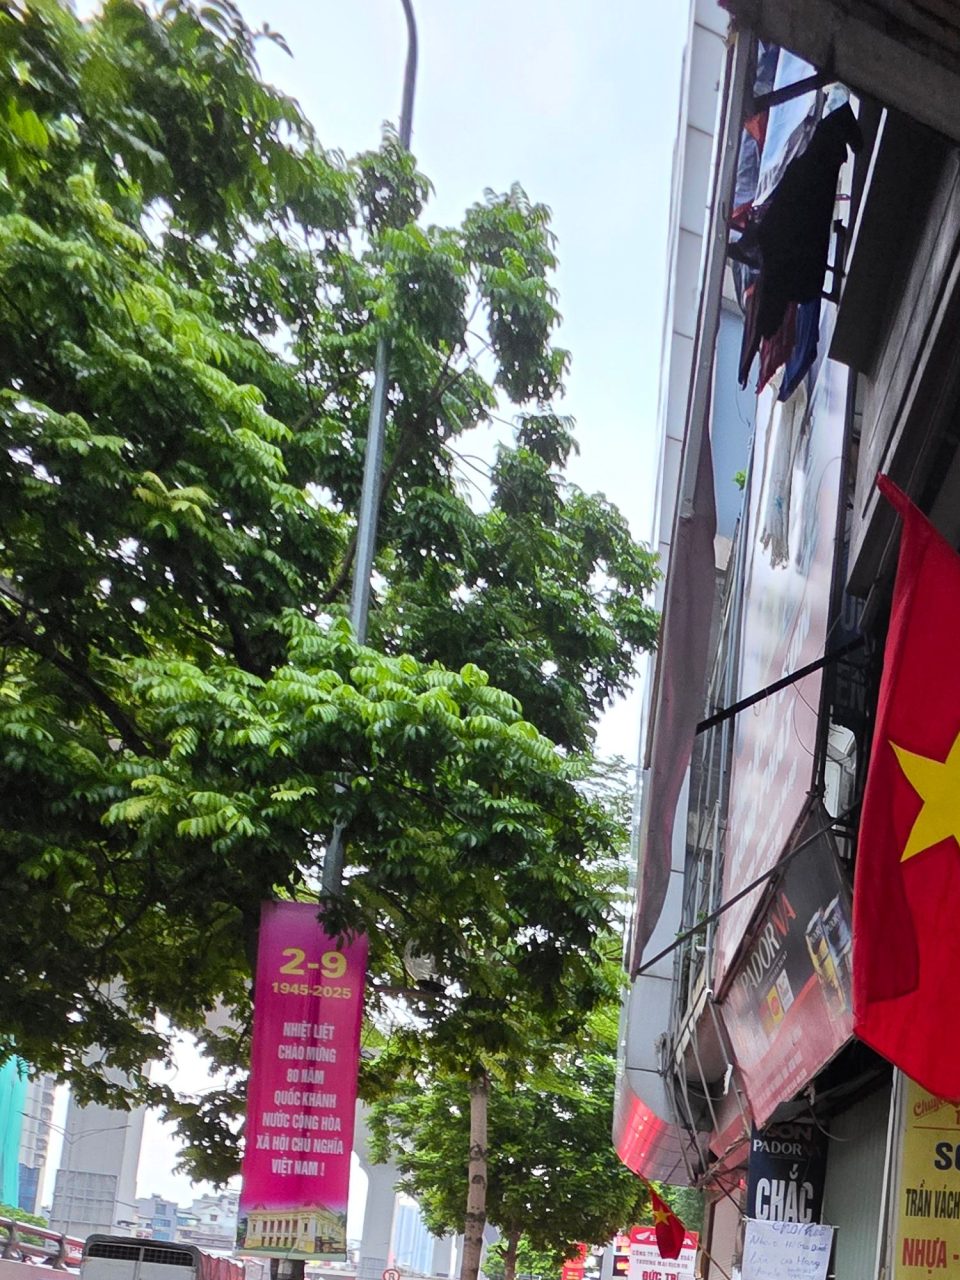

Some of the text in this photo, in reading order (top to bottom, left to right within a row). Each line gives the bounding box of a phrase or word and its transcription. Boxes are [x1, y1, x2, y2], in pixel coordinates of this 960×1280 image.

[280, 948, 347, 978] 2-9
[272, 982, 352, 999] 1945-2025
[283, 1021, 335, 1042] NHIỆT LIỆT
[278, 1043, 336, 1063] CHÀO MỪNG
[286, 1067, 325, 1084] 80 NĂM
[274, 1086, 336, 1108] QUỐC KHÁNH
[262, 1109, 341, 1132] NƯỚC CỘNG HÒA
[256, 1132, 344, 1154] XÃ HỘI CHỦ NGHĨA
[272, 1156, 293, 1177] VIỆT
[294, 1160, 318, 1176] NAM
[755, 1164, 814, 1224] CHẮC
[934, 1184, 960, 1219] VÁCH
[902, 1237, 947, 1274] NHỰA
